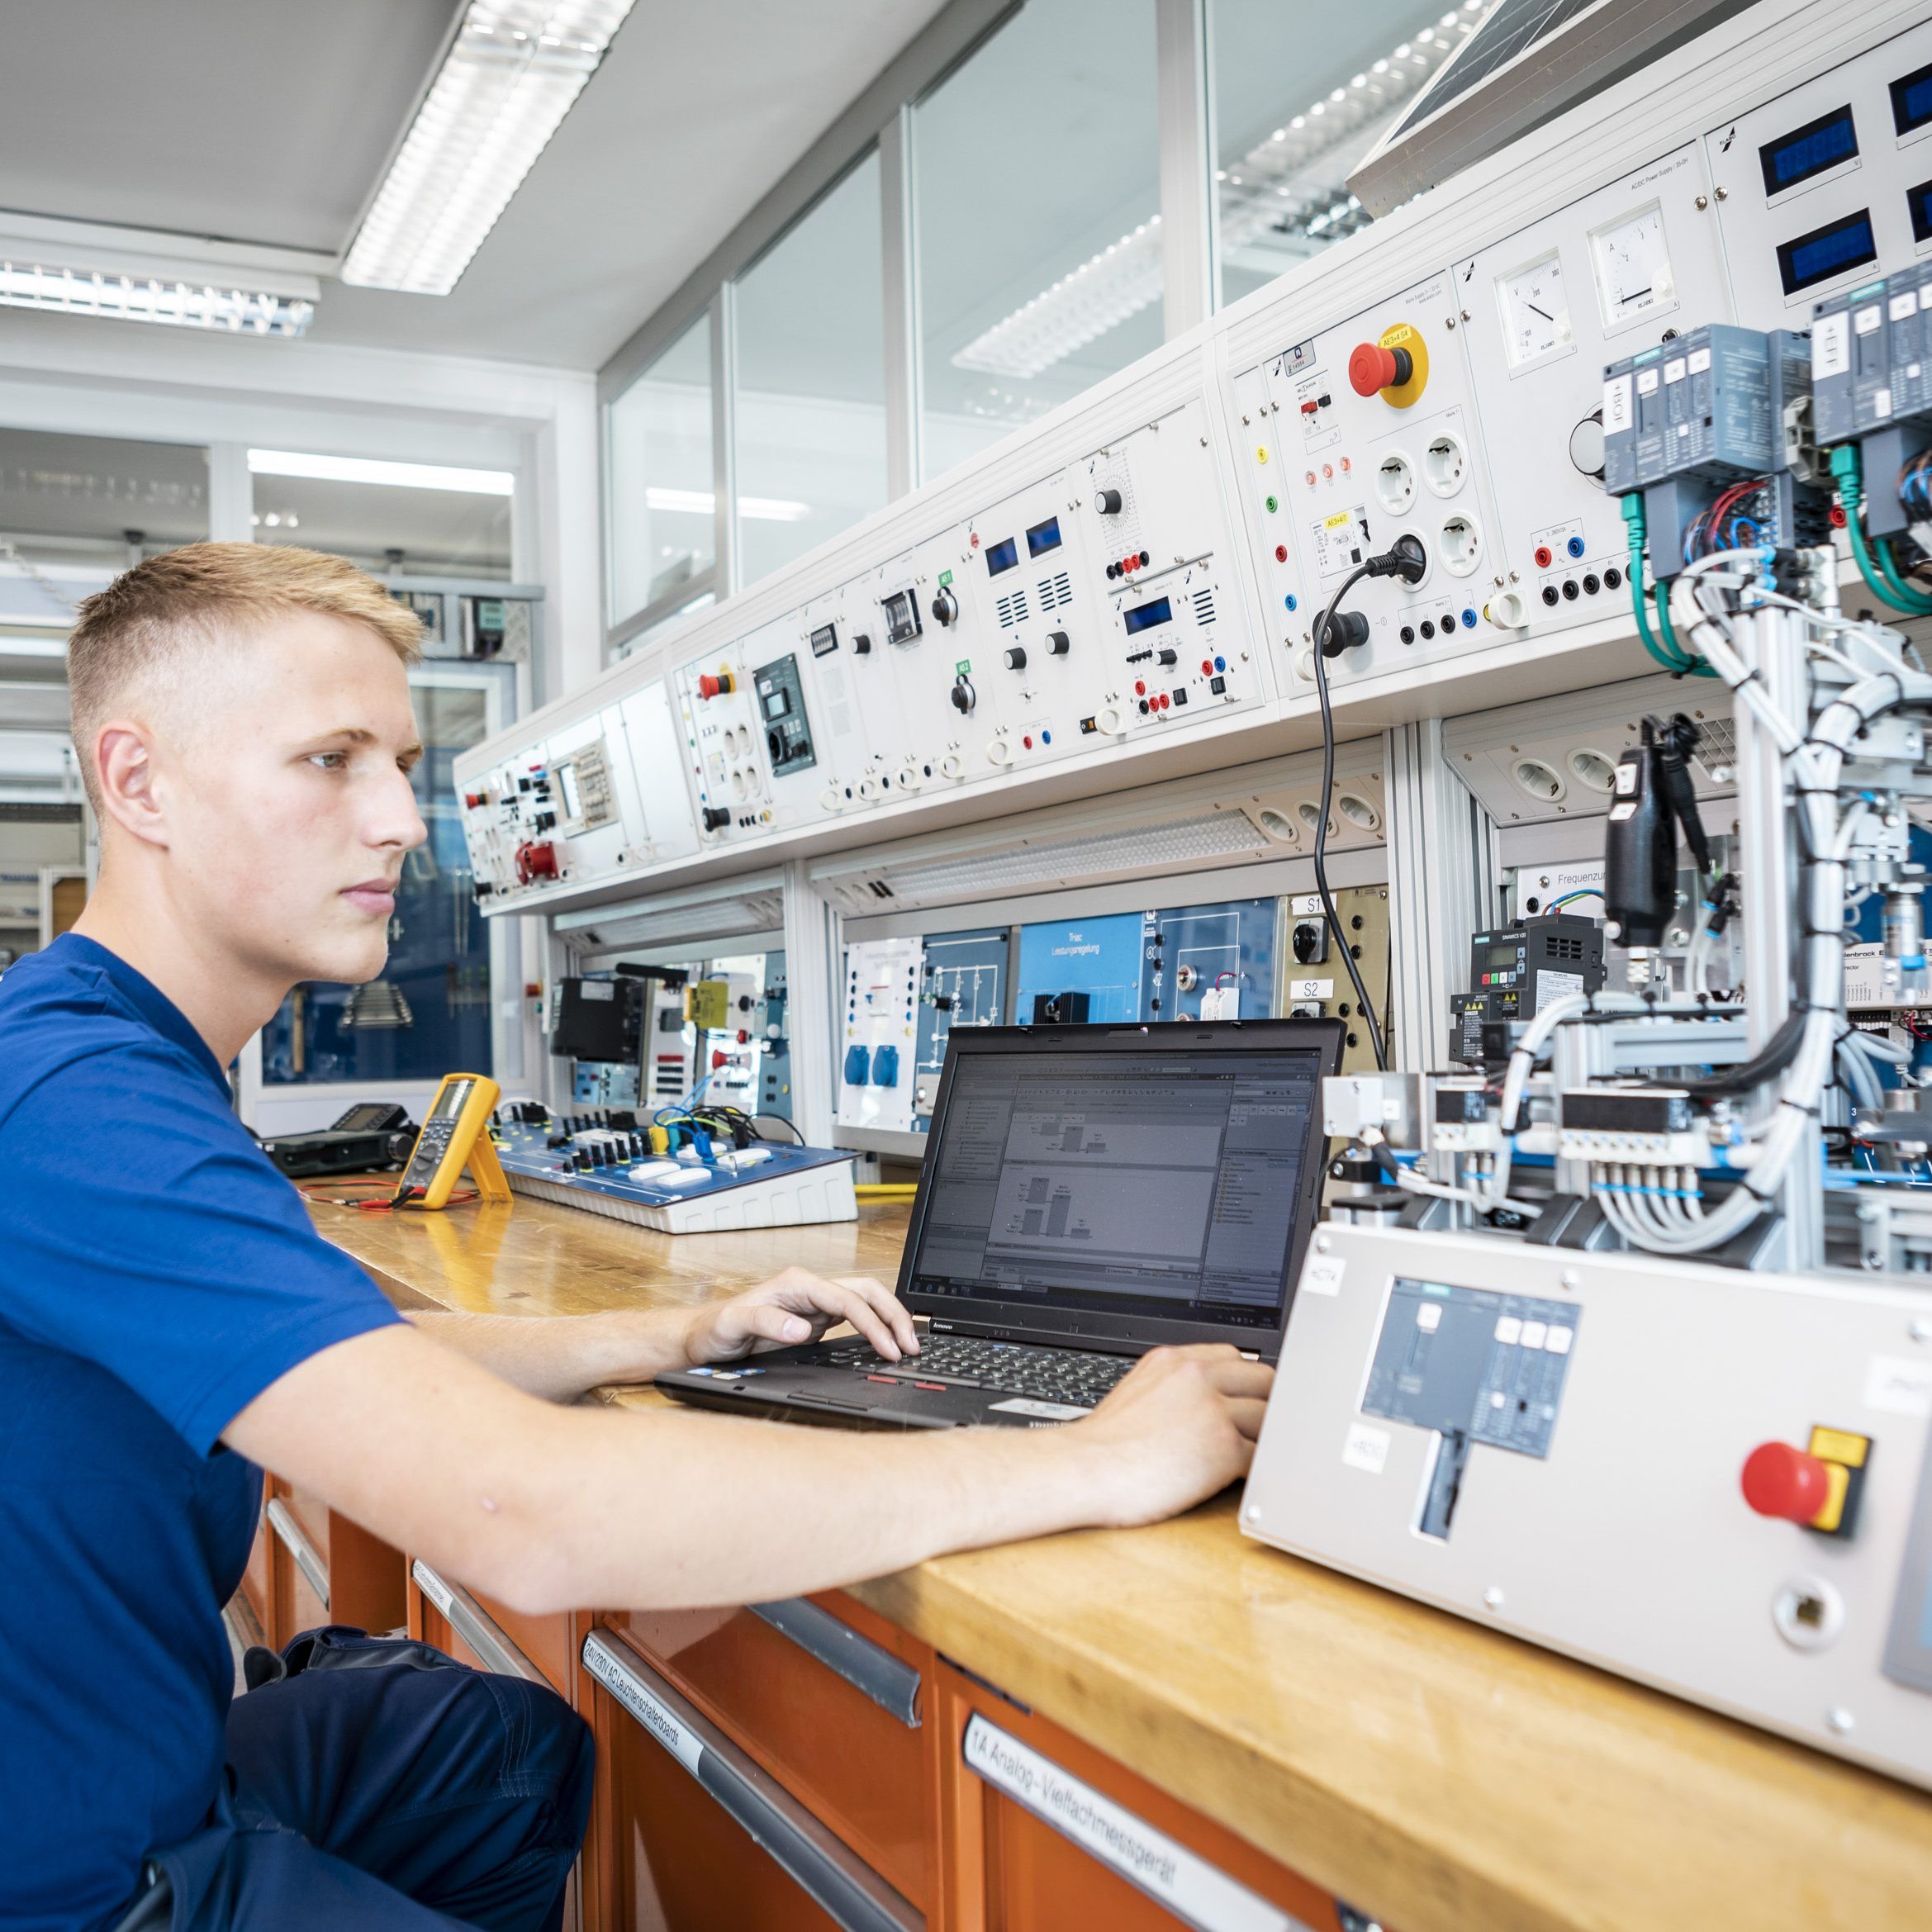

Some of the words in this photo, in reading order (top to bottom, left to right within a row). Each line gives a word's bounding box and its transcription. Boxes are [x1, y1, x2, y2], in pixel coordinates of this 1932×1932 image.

[1631, 179, 1645, 190] AC/DC
[1645, 174, 1659, 183] Power
[1659, 166, 1673, 177] Supply
[1610, 244, 1614, 252] A
[1308, 898, 1320, 912] S1
[1069, 933, 1082, 942] Triac
[1304, 982, 1318, 997] S2
[1851, 1108, 1857, 1116] 3
[608, 1666, 618, 1685] AC
[616, 1672, 679, 1747] Leuchtenschalterboards
[973, 1730, 988, 1756] 1A
[991, 1743, 1178, 1888] Analog-Vielfachmessgerät
